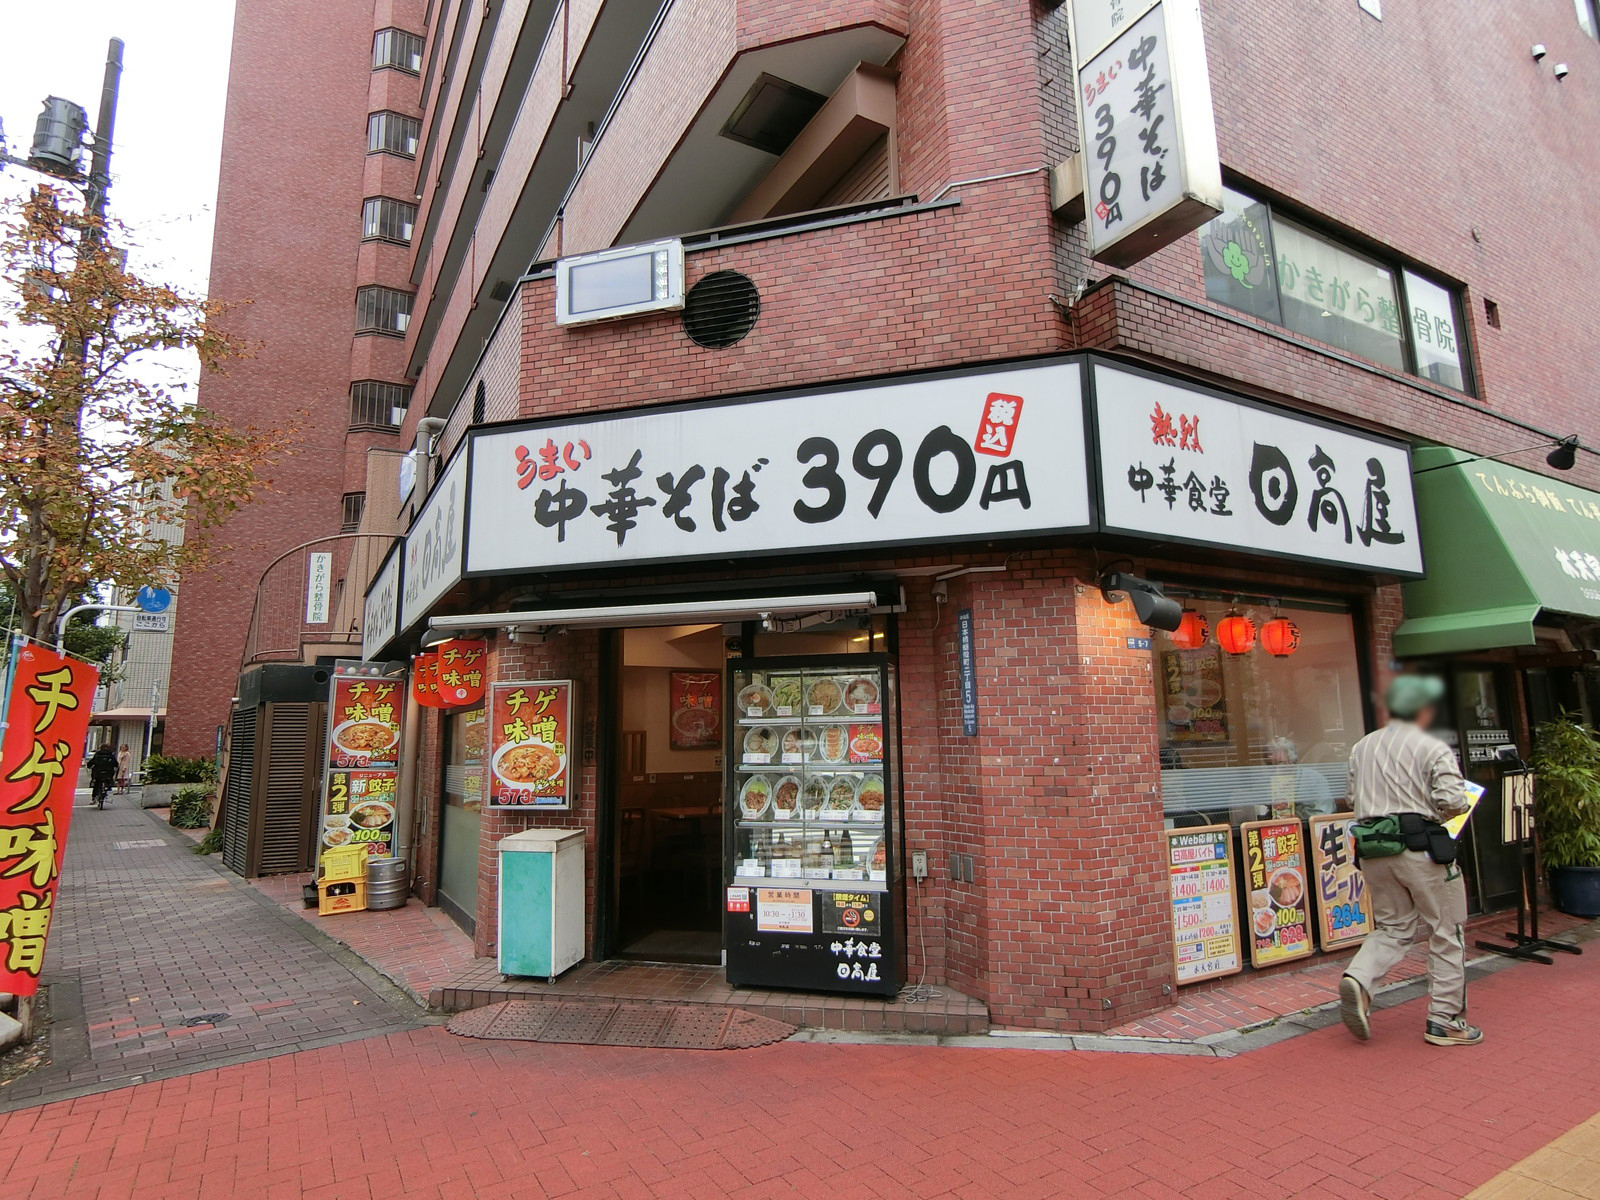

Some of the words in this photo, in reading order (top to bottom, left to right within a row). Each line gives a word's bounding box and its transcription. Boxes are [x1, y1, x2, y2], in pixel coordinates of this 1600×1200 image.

[1084, 60, 1122, 107] うまい
[1128, 35, 1168, 201] 中華そば
[1094, 103, 1122, 229] 390円
[1278, 253, 1455, 353] かきがら整骨院
[980, 398, 1017, 451] 税込
[1150, 401, 1203, 454] 熱烈
[515, 438, 591, 490] うまい
[534, 448, 769, 548] 中華そば
[793, 424, 1031, 523] 390円
[1127, 456, 1232, 516] 中華食堂
[1249, 440, 1405, 547] 日高屋
[422, 480, 457, 591] 日高屋
[312, 555, 326, 621] かきがら整骨院
[442, 670, 482, 688] 味噌
[443, 649, 482, 666] チゲ
[344, 702, 394, 722] 味噌
[348, 682, 396, 701] チゲ
[505, 687, 559, 716] チゲ
[502, 715, 559, 744] 味噌
[331, 773, 348, 814] 第2弾
[0, 665, 79, 976] チゲ味噌
[1173, 847, 1213, 861] 日高屋バイト
[1248, 830, 1265, 888] 第2弾
[1319, 822, 1348, 871] 生
[1320, 863, 1365, 903] ビール
[763, 910, 780, 918] 10:30
[830, 937, 881, 958] 中華食堂
[837, 961, 881, 981] 日高屋
